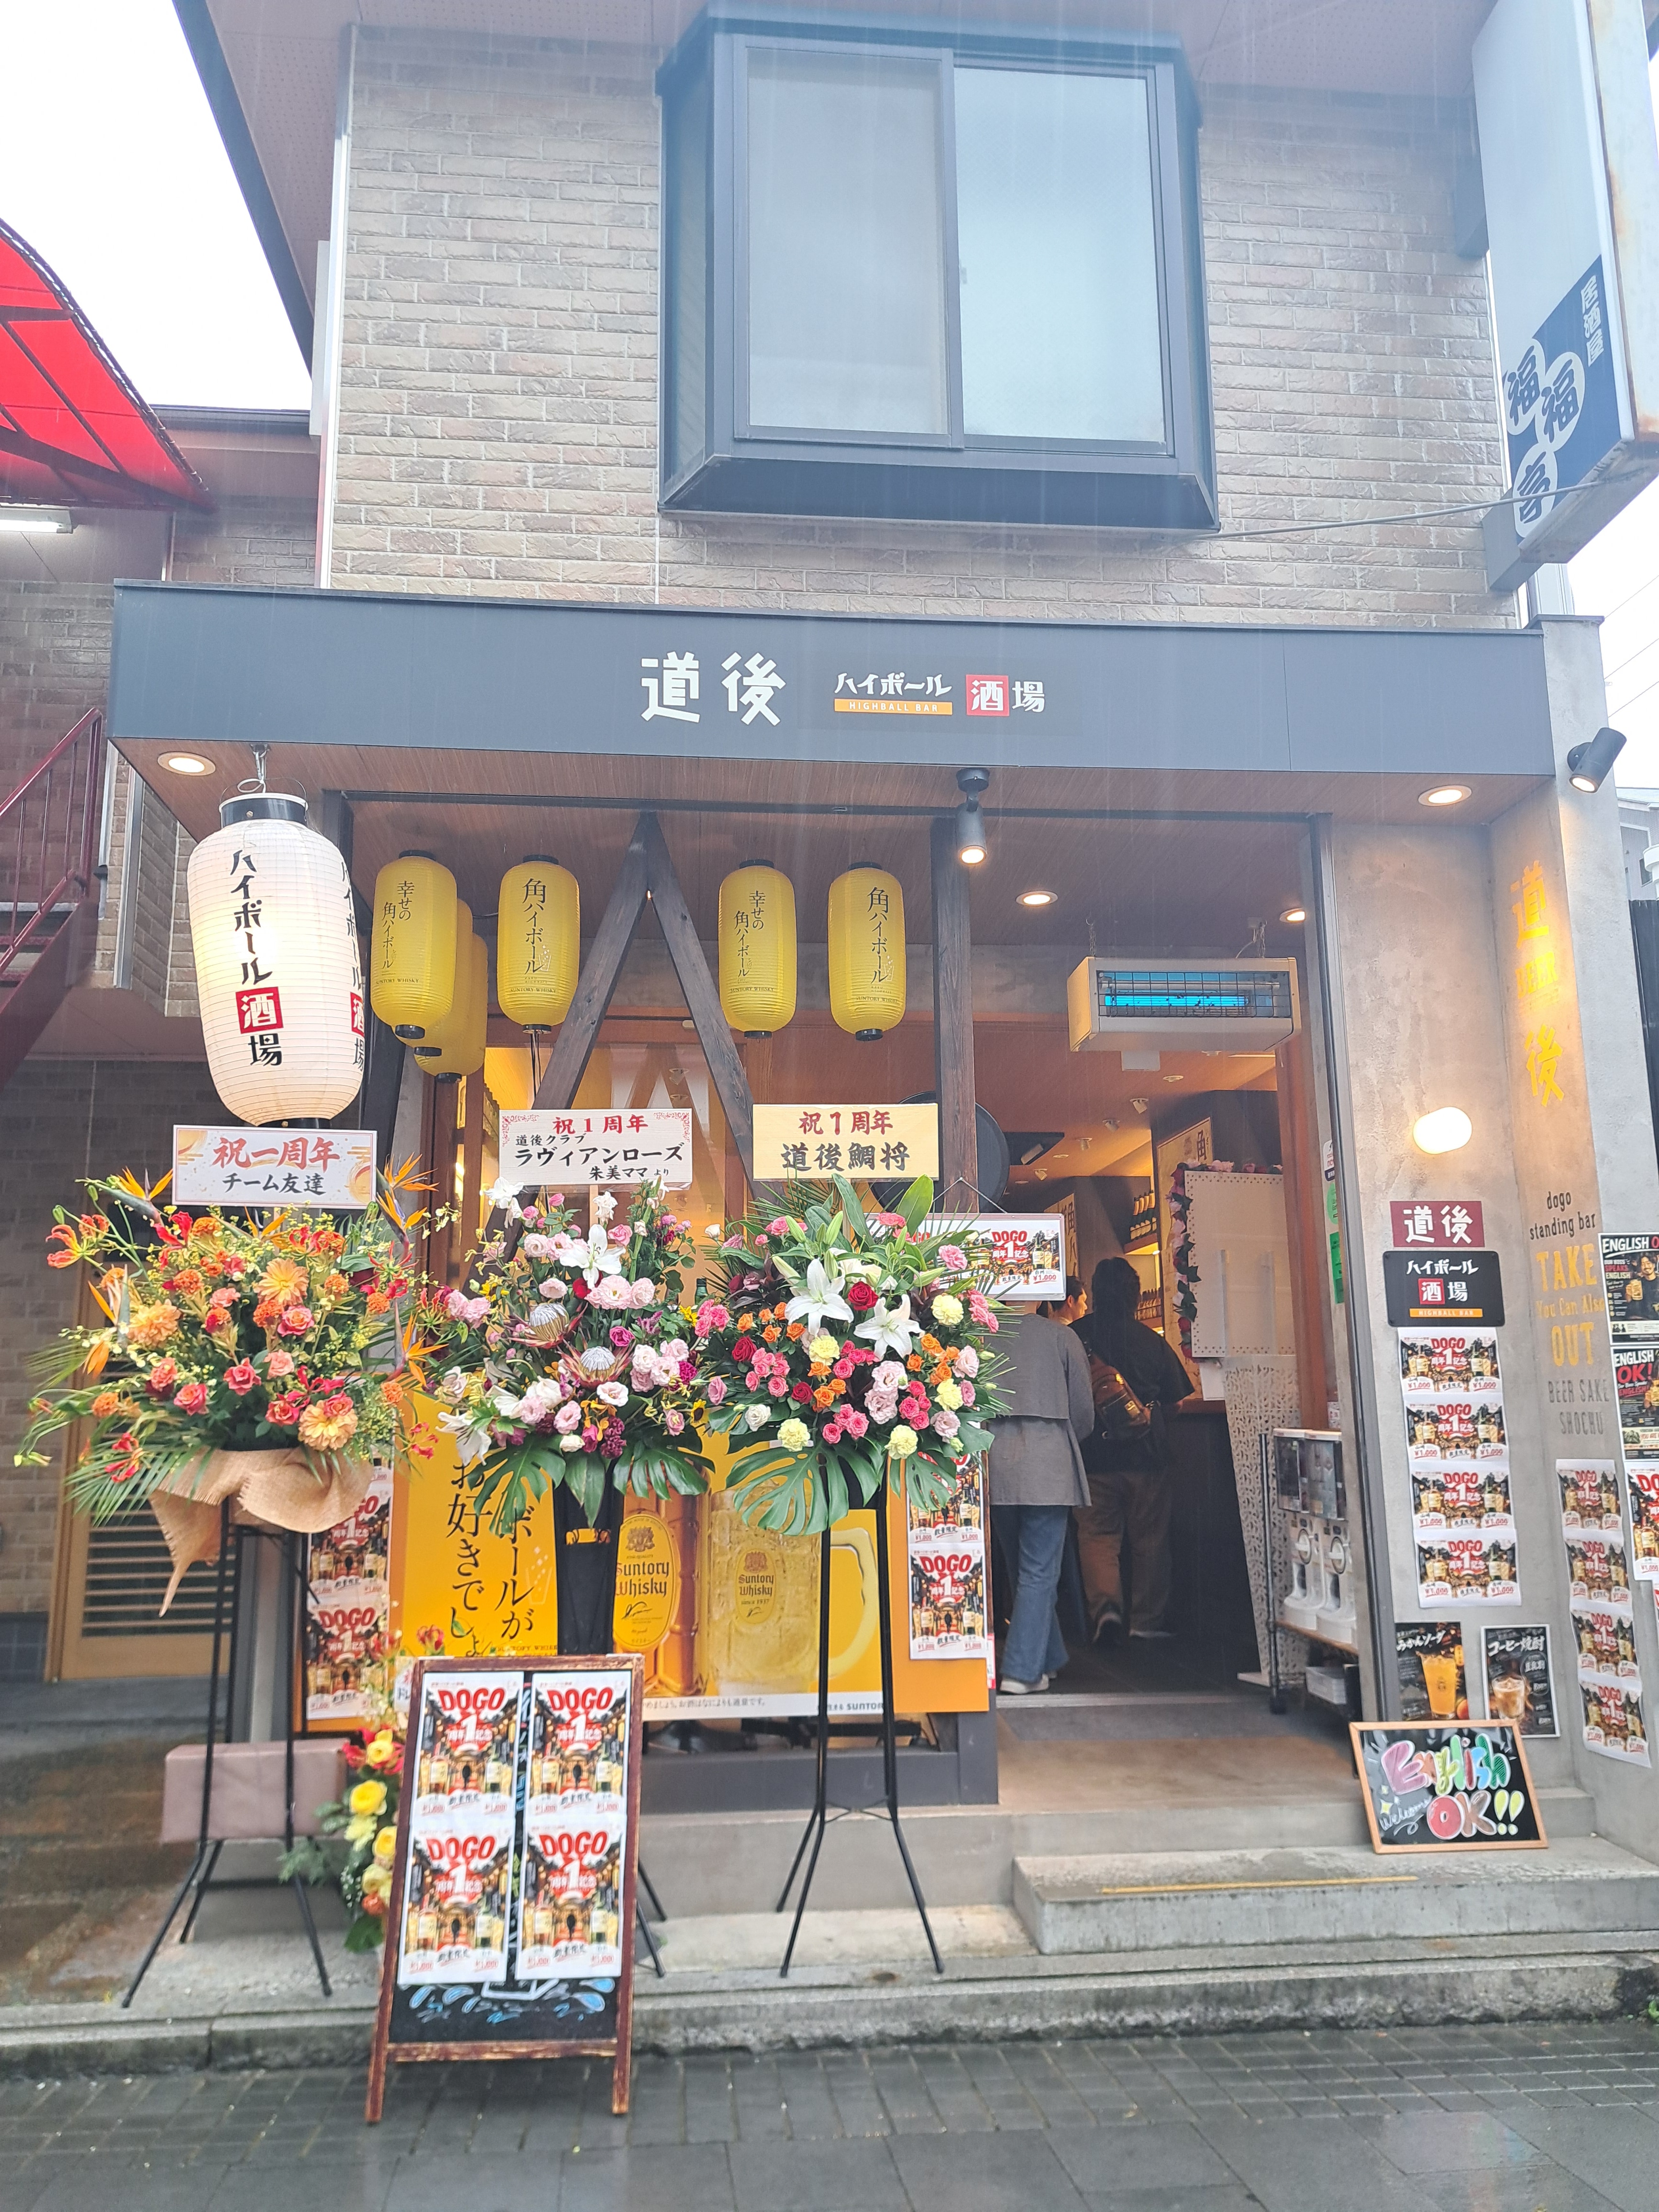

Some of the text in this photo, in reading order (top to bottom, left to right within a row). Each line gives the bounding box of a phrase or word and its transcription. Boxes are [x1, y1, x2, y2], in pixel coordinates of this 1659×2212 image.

[1582, 275, 1604, 366] 居酒屋
[641, 651, 786, 726] 道後
[834, 672, 1046, 713] ハイボール 酒場
[849, 701, 938, 712] HIGHBALL BAR
[397, 880, 415, 921] 幸せの
[749, 890, 765, 930] 幸せの
[382, 901, 396, 969] 角ハイボール
[522, 878, 547, 975] 角ハイボール
[867, 887, 889, 984] 角ハイボール
[734, 910, 749, 978] 角ハイボール
[1515, 952, 1558, 999] BEER
[798, 1110, 893, 1136] 祝1周年
[515, 1132, 587, 1147] 道後クラブ
[211, 1136, 341, 1173] 祝一周年
[514, 1142, 685, 1167] ラヴィアンローズ
[781, 1141, 910, 1172] 道後鯛将
[222, 1172, 327, 1195] チーム友達
[589, 1165, 669, 1181] 朱美ママ より
[1547, 1191, 1571, 1212] dogo
[991, 1230, 1028, 1242] DOGO
[1403, 1205, 1473, 1244] 道後
[1530, 1211, 1596, 1240] standing bar
[1603, 1236, 1659, 1253] ENGLISH O
[1406, 1259, 1479, 1275] ハイボール
[1536, 1243, 1598, 1292] TAKE
[1421, 1281, 1468, 1302] 酒場
[1536, 1300, 1556, 1318] You
[1559, 1297, 1578, 1316] Can
[1582, 1294, 1605, 1314] Also
[1431, 1337, 1466, 1349] DOGO
[1551, 1321, 1594, 1367] OUT
[1614, 1349, 1655, 1367] ENGLISH
[1617, 1362, 1652, 1383] OK!
[1548, 1379, 1610, 1403] BEER SAKE
[1437, 1404, 1471, 1416] DOGO
[1559, 1412, 1604, 1435] SHOCHU
[1443, 1472, 1478, 1484] DOGO
[1637, 1474, 1659, 1492] DO
[1448, 1540, 1482, 1552] DOGO
[617, 1561, 669, 1577] Suntory
[919, 1554, 972, 1573] DOGO
[616, 1578, 668, 1598] Whisky
[739, 1574, 774, 1585] Suntory
[740, 1585, 773, 1597] Whisky
[319, 1607, 376, 1628] DOGO
[1488, 1635, 1545, 1657] コーヒー焼酎
[438, 1687, 506, 1711] DOGO
[547, 1687, 613, 1711] DOGO
[1427, 1789, 1525, 1840] OK!!
[426, 1836, 496, 1860] DOGO
[539, 1831, 608, 1857] DOGO
